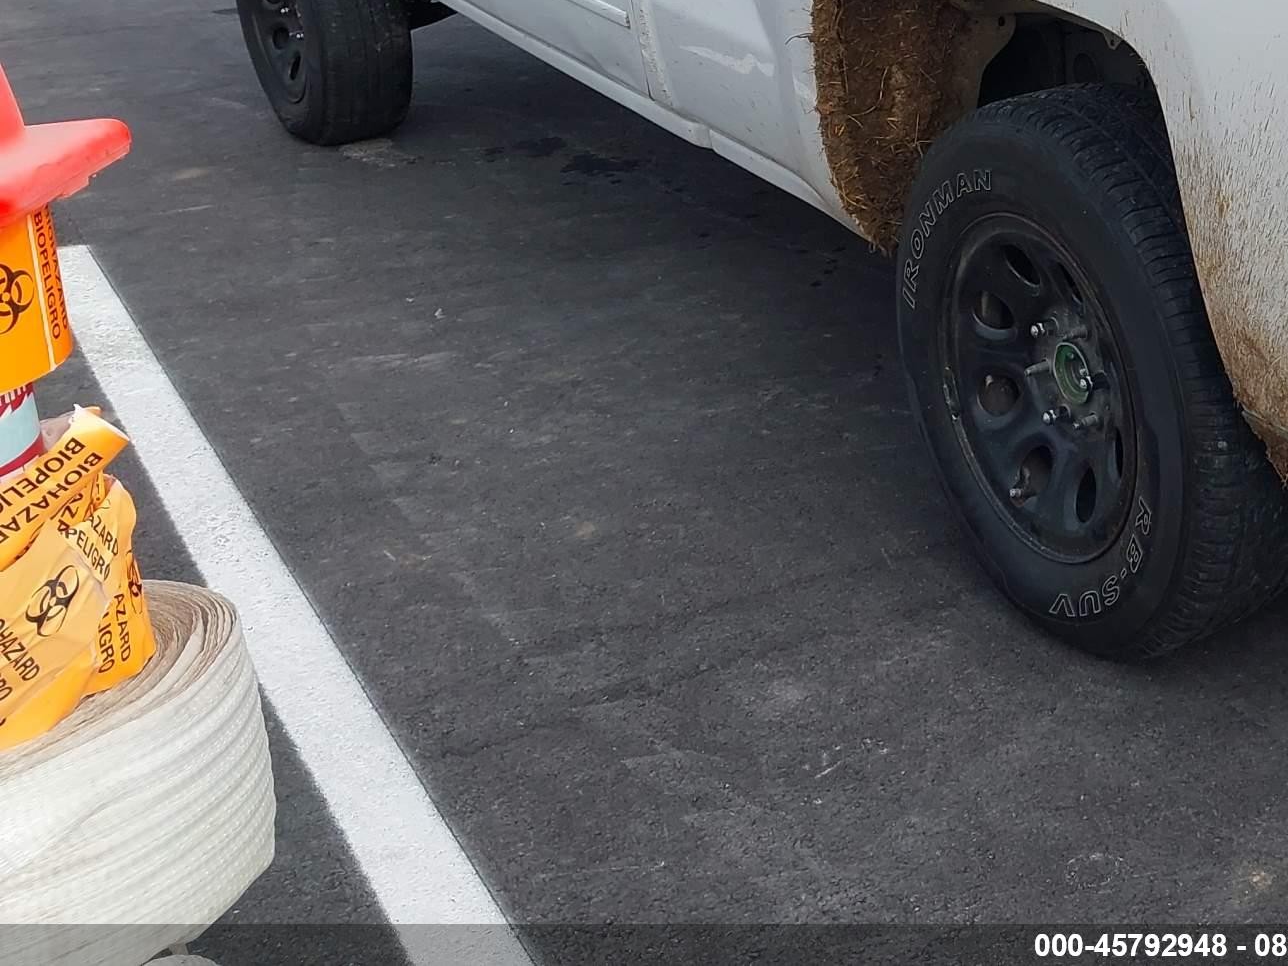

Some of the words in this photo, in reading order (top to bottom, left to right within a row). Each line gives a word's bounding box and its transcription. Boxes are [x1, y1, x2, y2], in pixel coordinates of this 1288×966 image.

[34, 211, 61, 340] BIOPELIGRO
[902, 169, 992, 309] IRONMAN
[0, 437, 86, 514] BIOPELI
